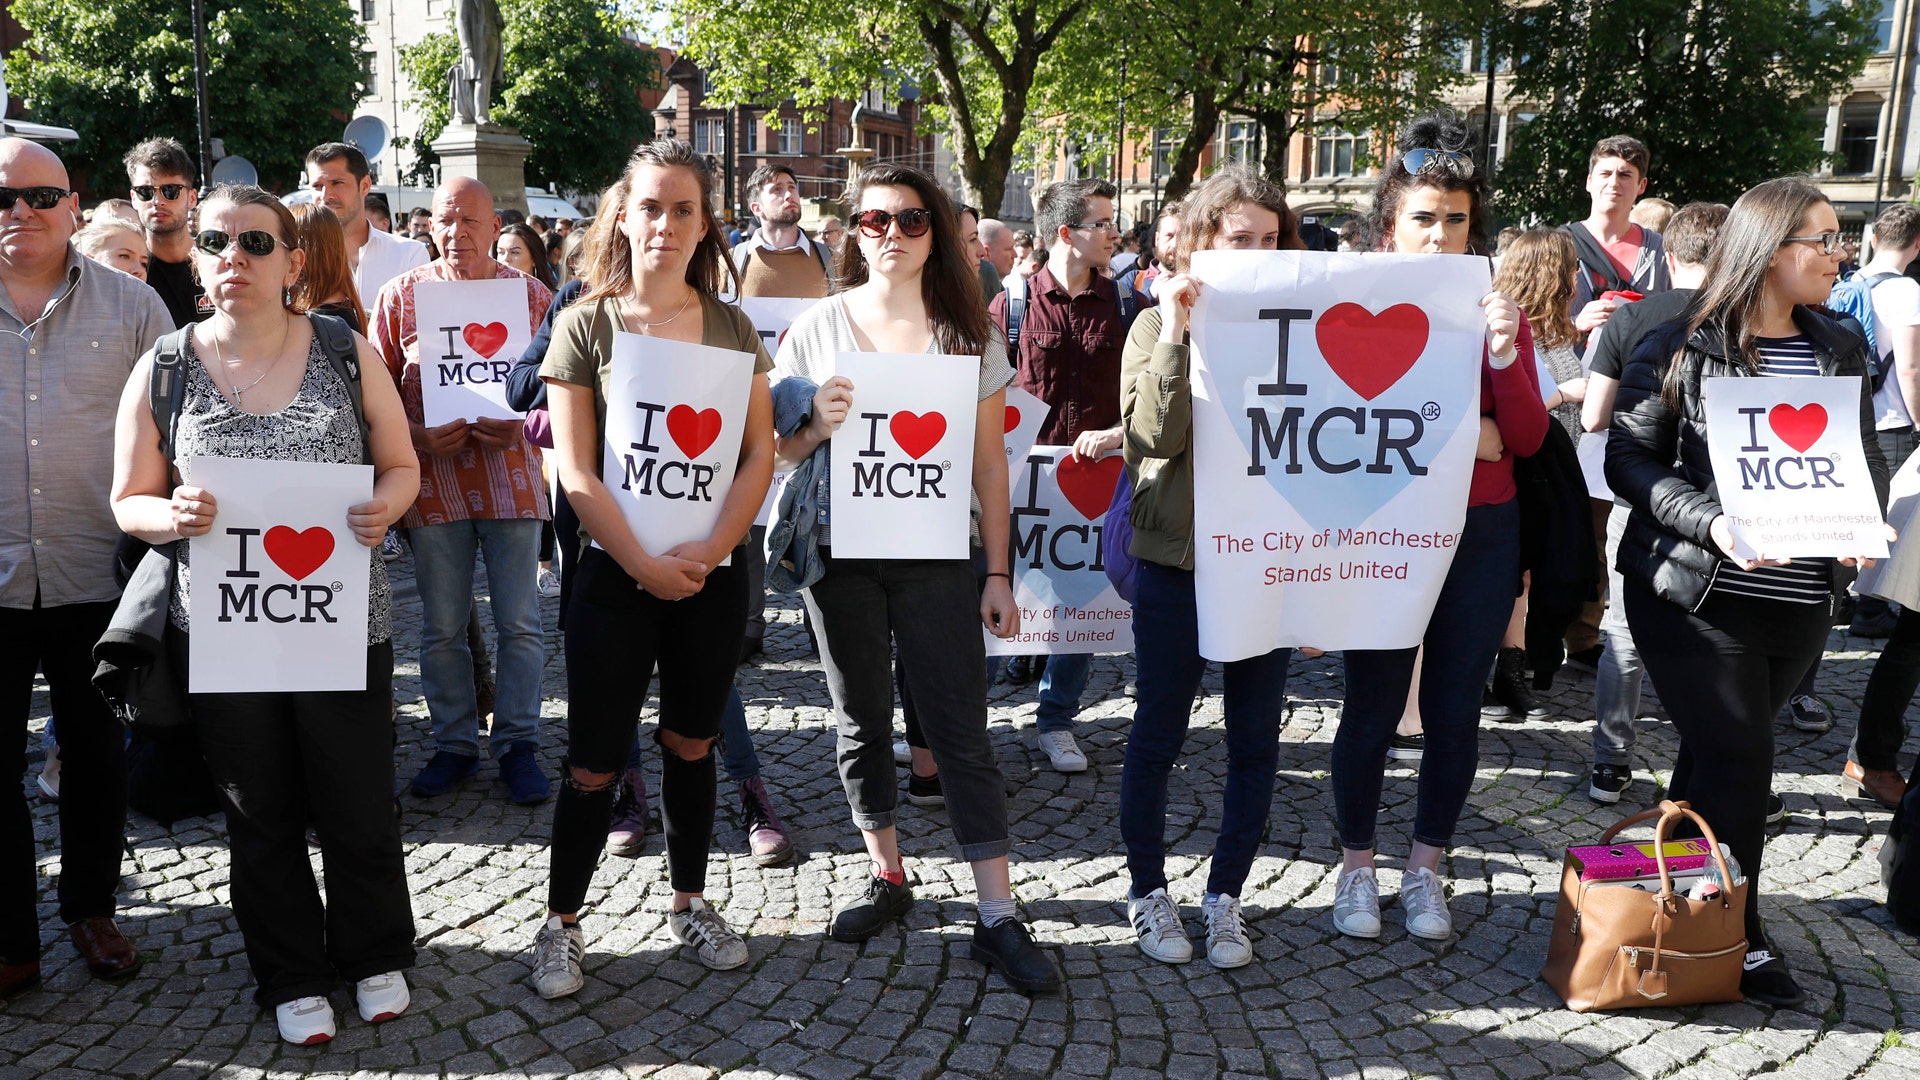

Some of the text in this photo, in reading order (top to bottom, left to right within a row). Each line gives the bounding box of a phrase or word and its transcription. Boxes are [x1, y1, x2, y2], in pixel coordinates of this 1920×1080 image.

[439, 326, 463, 360] I
[1258, 308, 1313, 396] I
[437, 360, 511, 387] MCR
[630, 401, 666, 454] I
[858, 412, 889, 457] I
[1246, 403, 1440, 476] MCR uk
[1738, 407, 1769, 452] I
[621, 453, 715, 502] MCR
[852, 462, 947, 499] MCR
[1013, 455, 1055, 516] I
[1736, 456, 1845, 490] MCR
[1729, 514, 1878, 528] The City of Manchester
[1760, 530, 1854, 544] Stands United
[225, 527, 261, 578] I
[1211, 527, 1463, 554] The City of Manchester
[1263, 561, 1408, 586] Stands United
[218, 583, 338, 624] MCR
[1018, 605, 1132, 622] ity of Manches
[1066, 628, 1115, 643] United
[1746, 950, 1770, 963] NIKE
